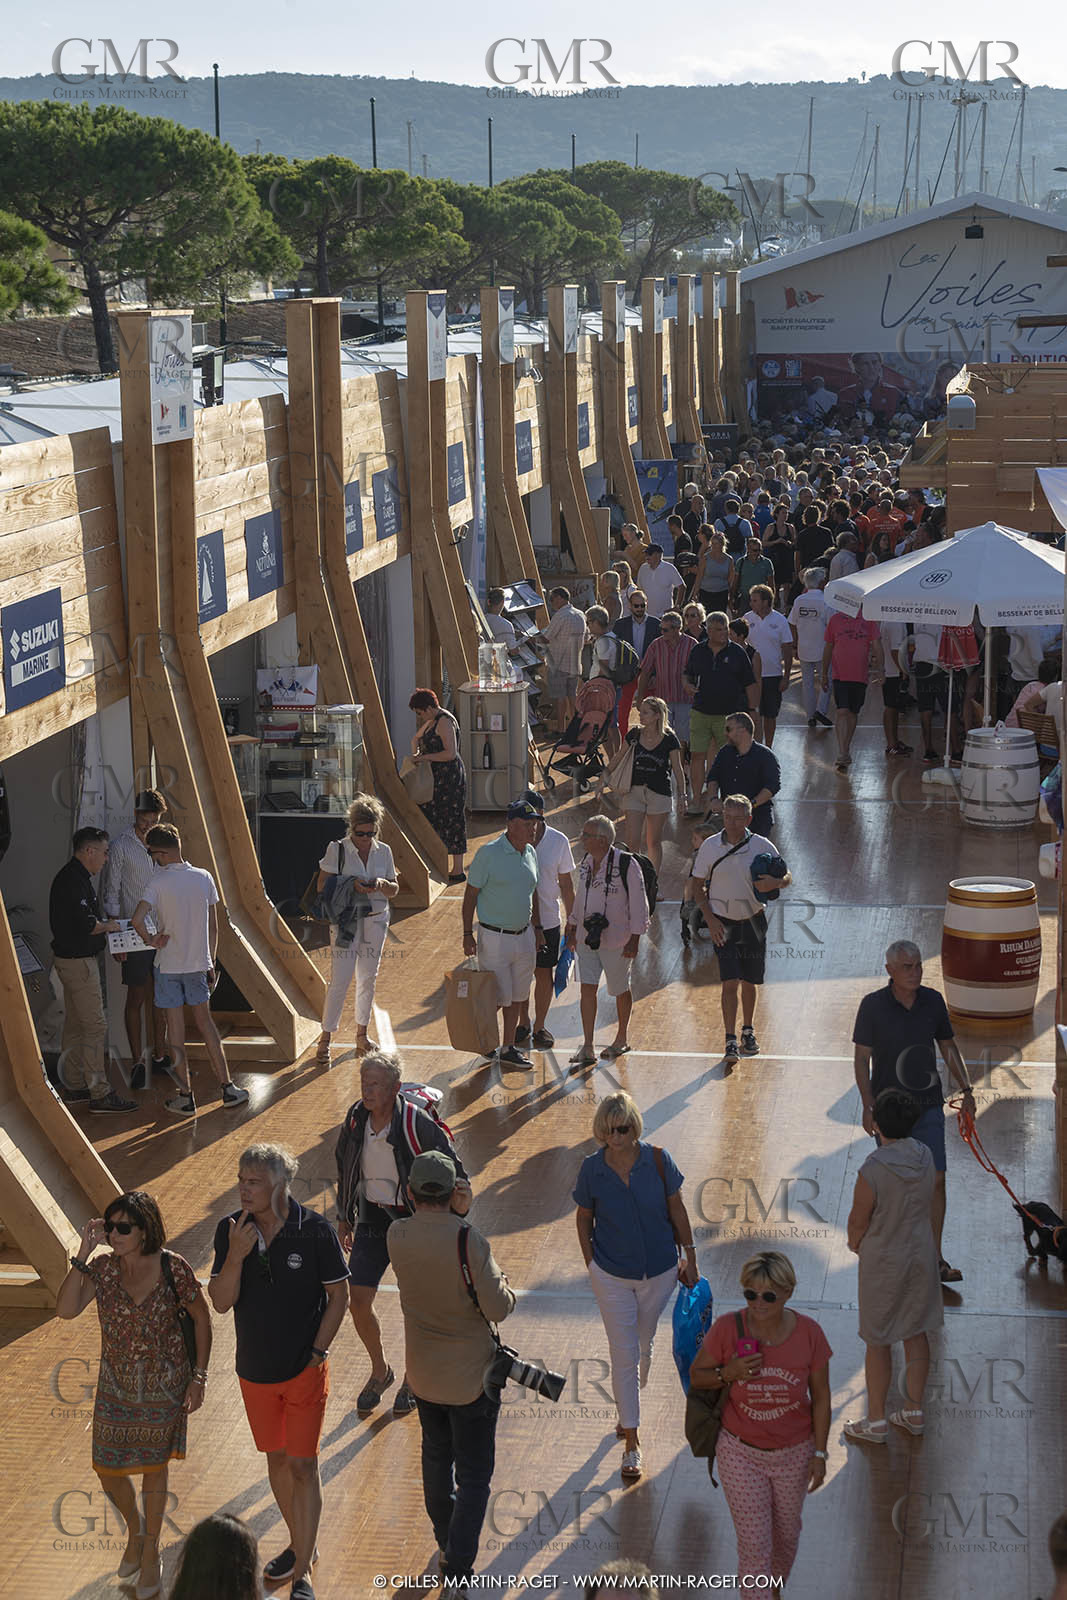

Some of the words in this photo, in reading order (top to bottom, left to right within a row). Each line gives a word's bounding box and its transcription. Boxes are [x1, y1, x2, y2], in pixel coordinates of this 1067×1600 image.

[900, 244, 940, 268] Les
[881, 244, 1042, 328] Voiles
[881, 606, 913, 614] BESSERAT
[924, 608, 957, 616] BELLEFON
[998, 610, 1032, 618] BESSERAT
[1033, 609, 1044, 617] DE
[21, 619, 59, 653] SUZUKI
[22, 653, 49, 679] MARINE
